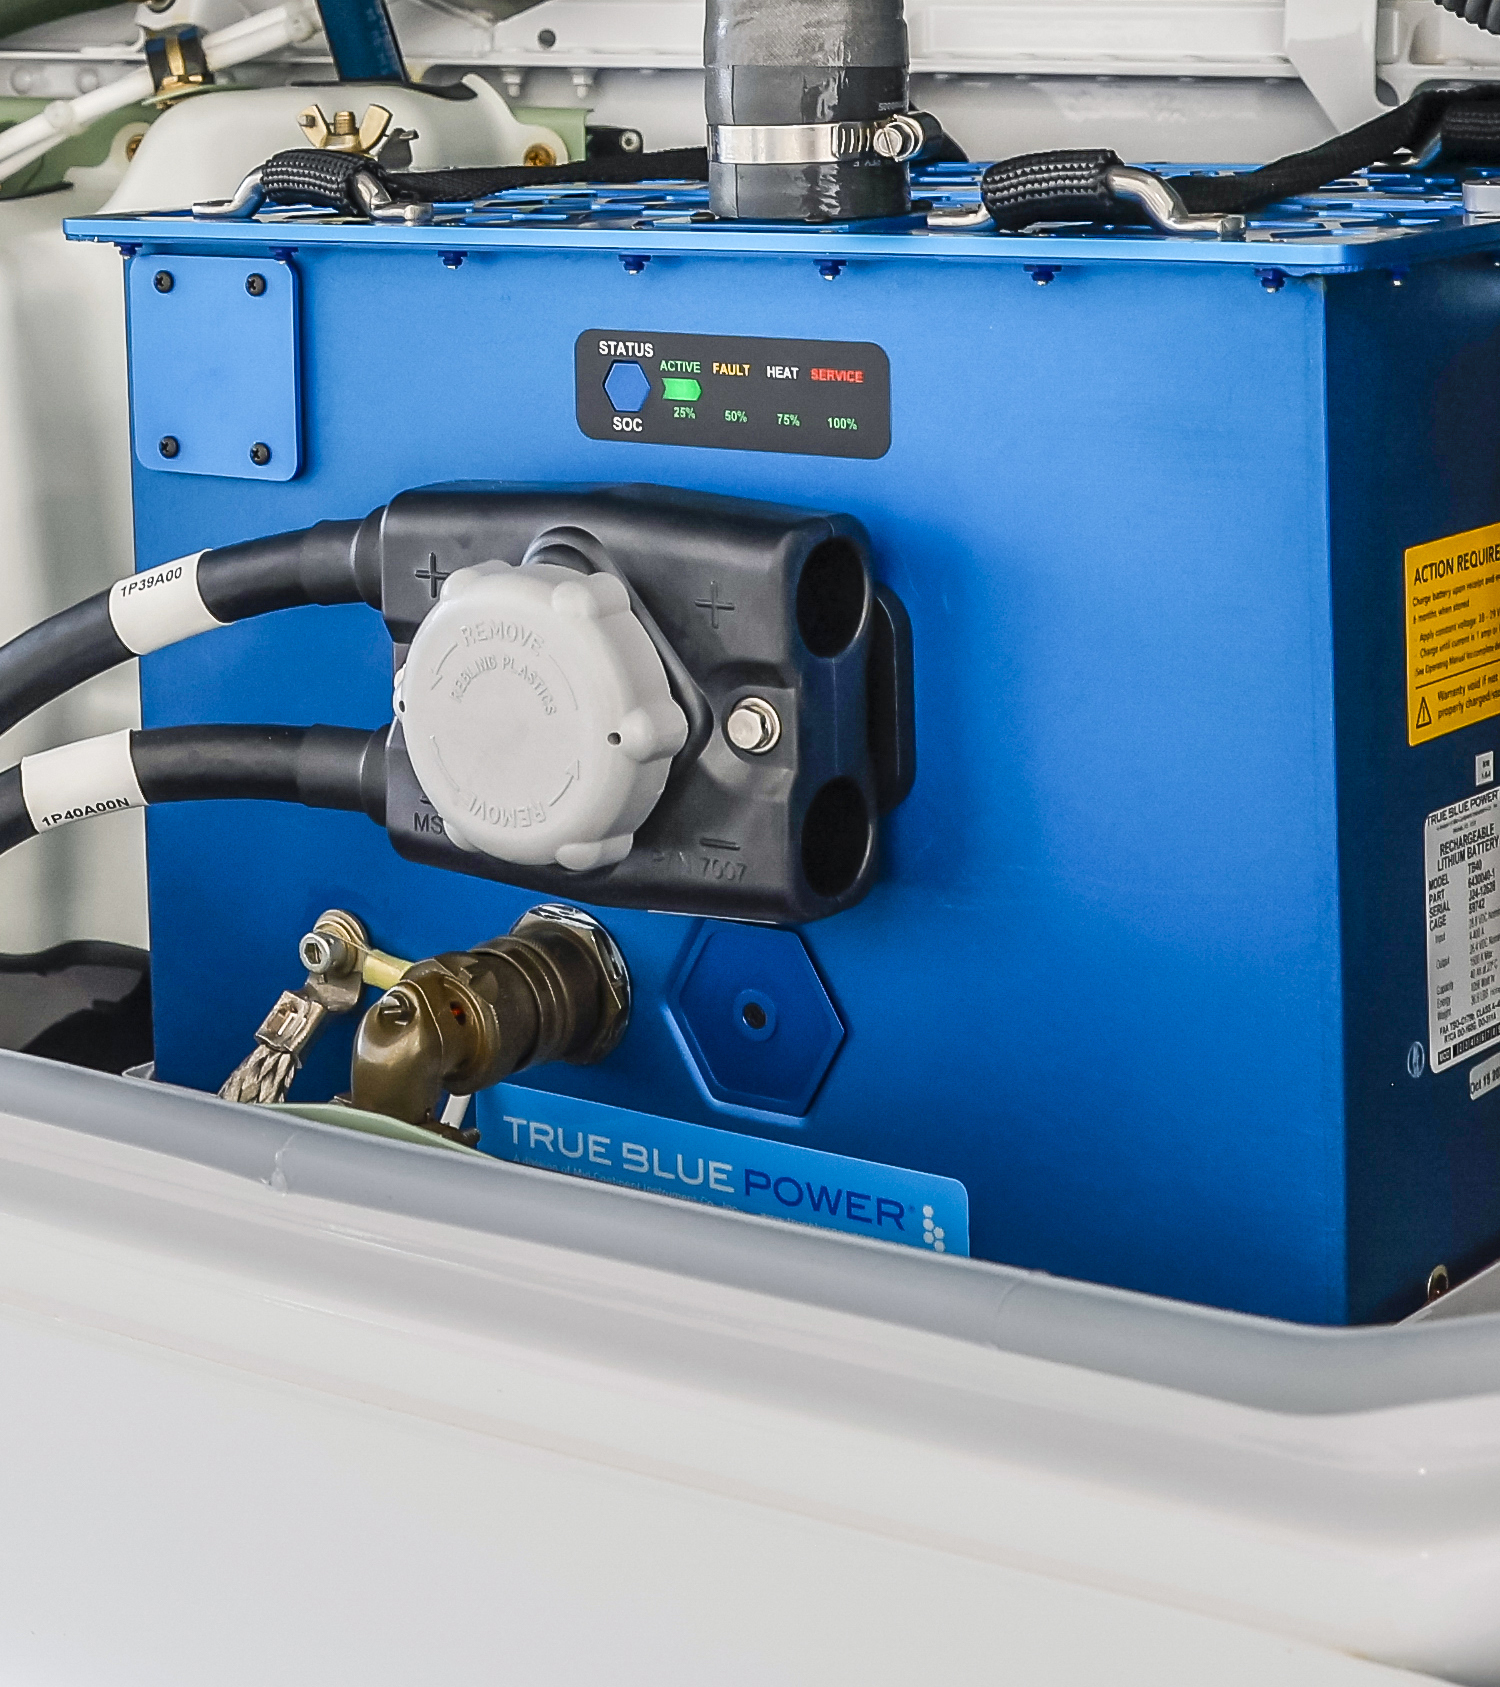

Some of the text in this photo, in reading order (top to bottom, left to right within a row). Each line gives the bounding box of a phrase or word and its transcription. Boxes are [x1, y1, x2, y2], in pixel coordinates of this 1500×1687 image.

[599, 340, 654, 358] STATUS
[660, 360, 863, 383] ACTIVE FAULT HEAT SERVICE
[612, 416, 643, 432] SOC
[673, 406, 858, 431] 25% 50% 75% 100%
[120, 566, 183, 598] 1P39A00
[1414, 557, 1454, 586] ACTION
[460, 620, 546, 657] REMOVE
[503, 655, 557, 716] PLASTICS
[41, 797, 131, 828] 1P40A00N
[1427, 809, 1448, 826] TRUE
[1448, 800, 1469, 818] BLUE
[1470, 791, 1499, 809] POWER
[1437, 835, 1499, 871] LITHIUM BATTERY
[1440, 823, 1495, 856] RECHARGEABLE
[702, 857, 747, 883] 7007
[1429, 873, 1449, 892] MODEL
[1429, 889, 1445, 905] PART
[1429, 900, 1450, 918] SERIAL
[1429, 914, 1446, 931] CAGE
[503, 1115, 611, 1167] TRUE
[622, 1141, 735, 1193] BLUE
